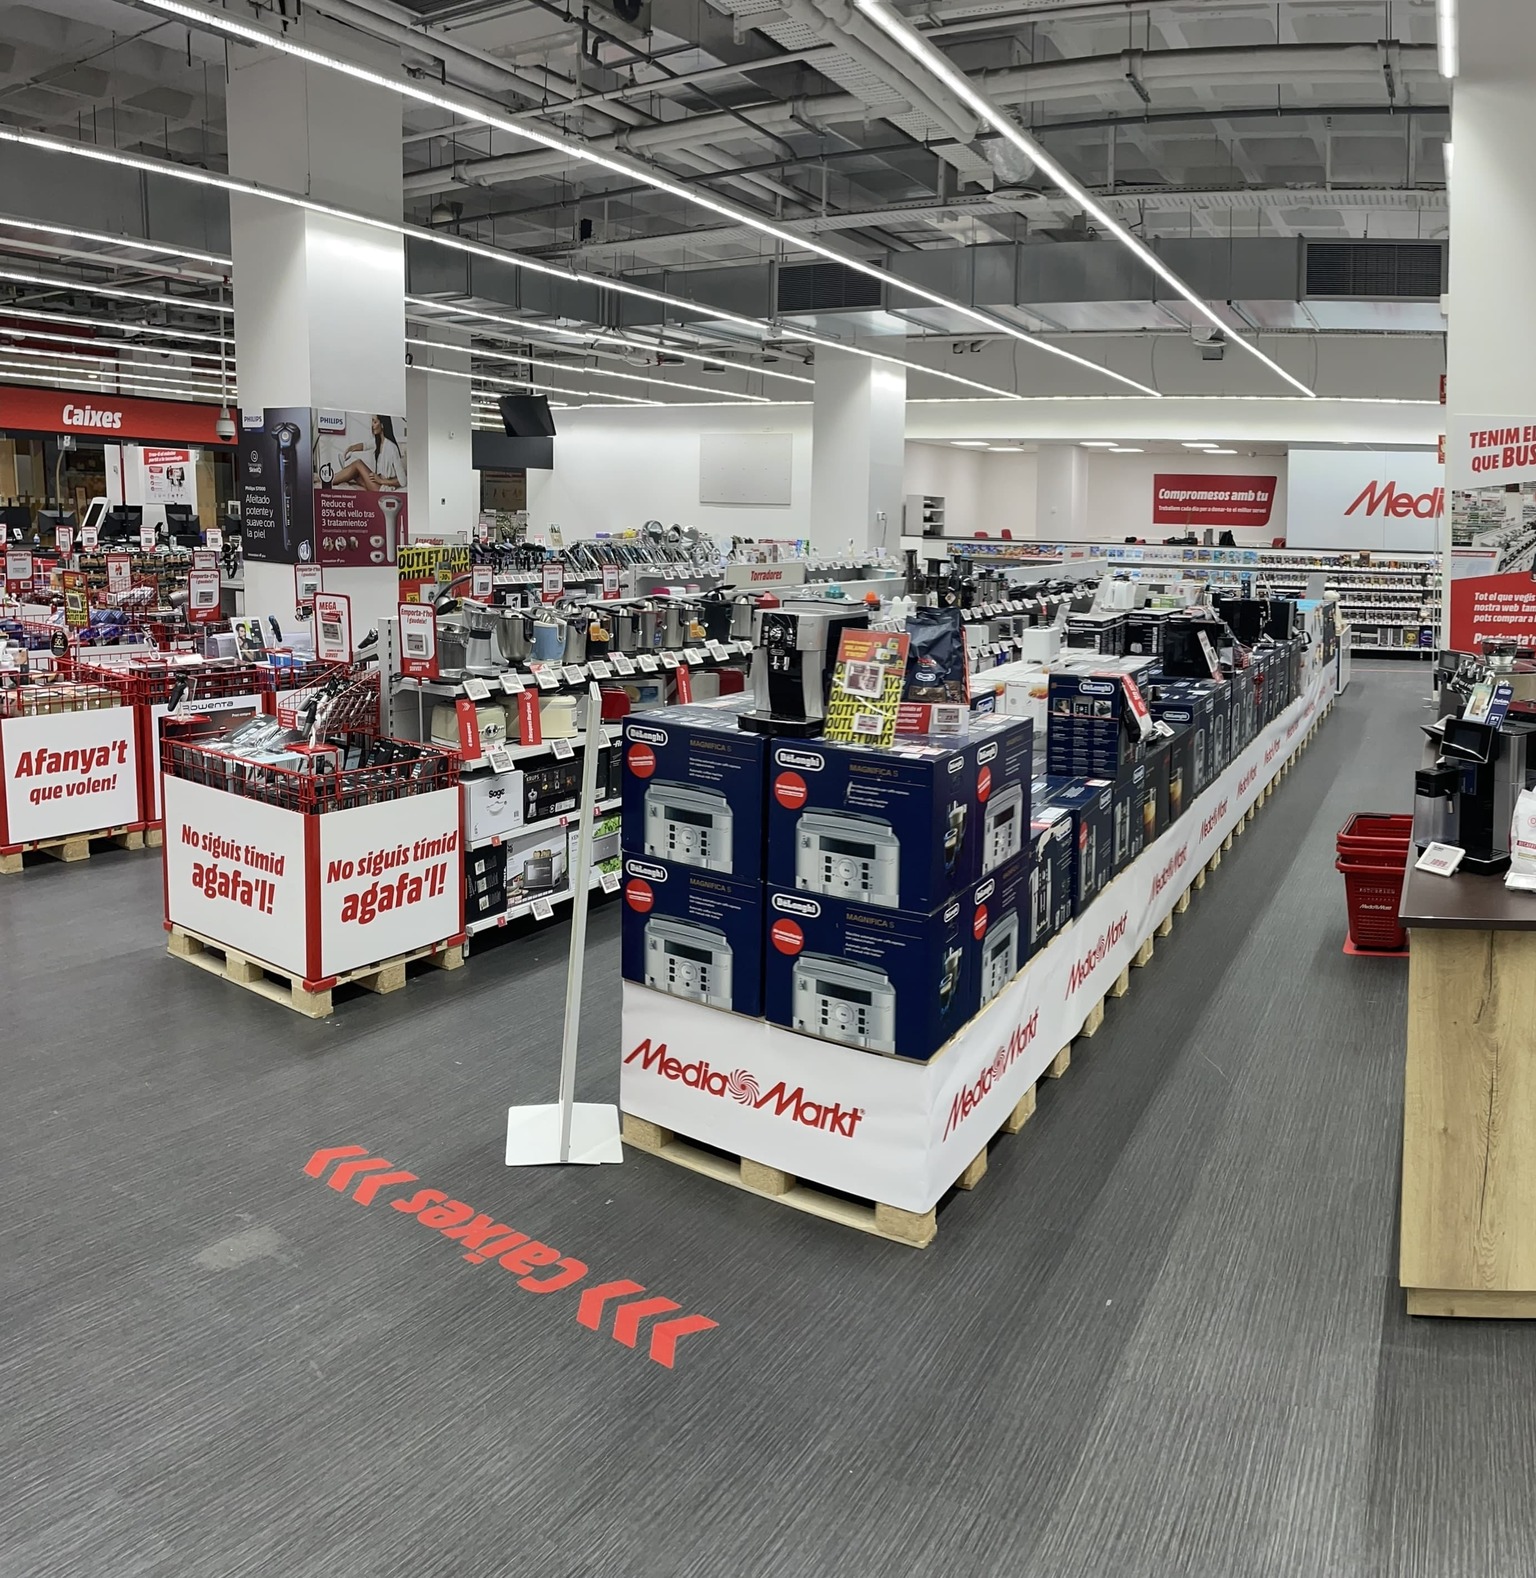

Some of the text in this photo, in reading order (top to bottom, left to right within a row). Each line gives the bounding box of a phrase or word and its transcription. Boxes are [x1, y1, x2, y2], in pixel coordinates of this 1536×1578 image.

[62, 404, 123, 429] Caixes
[320, 416, 344, 425] PHILIPS
[1469, 427, 1520, 449] TENIM
[1471, 454, 1499, 473] QUE
[246, 494, 270, 504] Afeitado
[1158, 488, 1269, 502] Compromesos amb tu
[1343, 480, 1445, 519] Medi
[321, 499, 354, 508] Reduce el
[246, 507, 269, 516] potente
[347, 510, 363, 518] vello
[246, 519, 275, 528] suave con
[322, 519, 368, 527] 3 tratamientos
[247, 528, 266, 540] la piel
[398, 547, 469, 569] OUTLET DAYS
[1474, 592, 1489, 601] Tot
[1490, 592, 1497, 601] el
[1498, 594, 1513, 603] que
[1514, 592, 1535, 603] vegis
[318, 601, 337, 610] MEGA
[401, 608, 432, 617] Emporta-t'ho
[1474, 603, 1500, 612] nostra
[1501, 603, 1519, 612] web
[1473, 613, 1491, 623] pots
[1492, 614, 1527, 624] comprar
[1527, 615, 1533, 623] a
[689, 739, 726, 751] MAGNIFICA
[14, 740, 128, 779] Afanya't
[849, 764, 892, 776] MAGNIFICA
[29, 774, 117, 806] que volen!
[488, 788, 505, 800] Sage
[181, 824, 285, 877] No siguis tímid
[327, 830, 458, 884] No siguis tímid
[192, 862, 275, 915] agafa'l!
[689, 877, 726, 892] MAGNIFICA
[341, 862, 448, 925] agafa'l!
[846, 912, 888, 927] MAGNIFICA
[1065, 911, 1129, 1001] Media Markt
[943, 1006, 1040, 1142] Media Markt
[623, 1037, 864, 1139] Media Markt
[390, 1188, 589, 1294] Caixes
